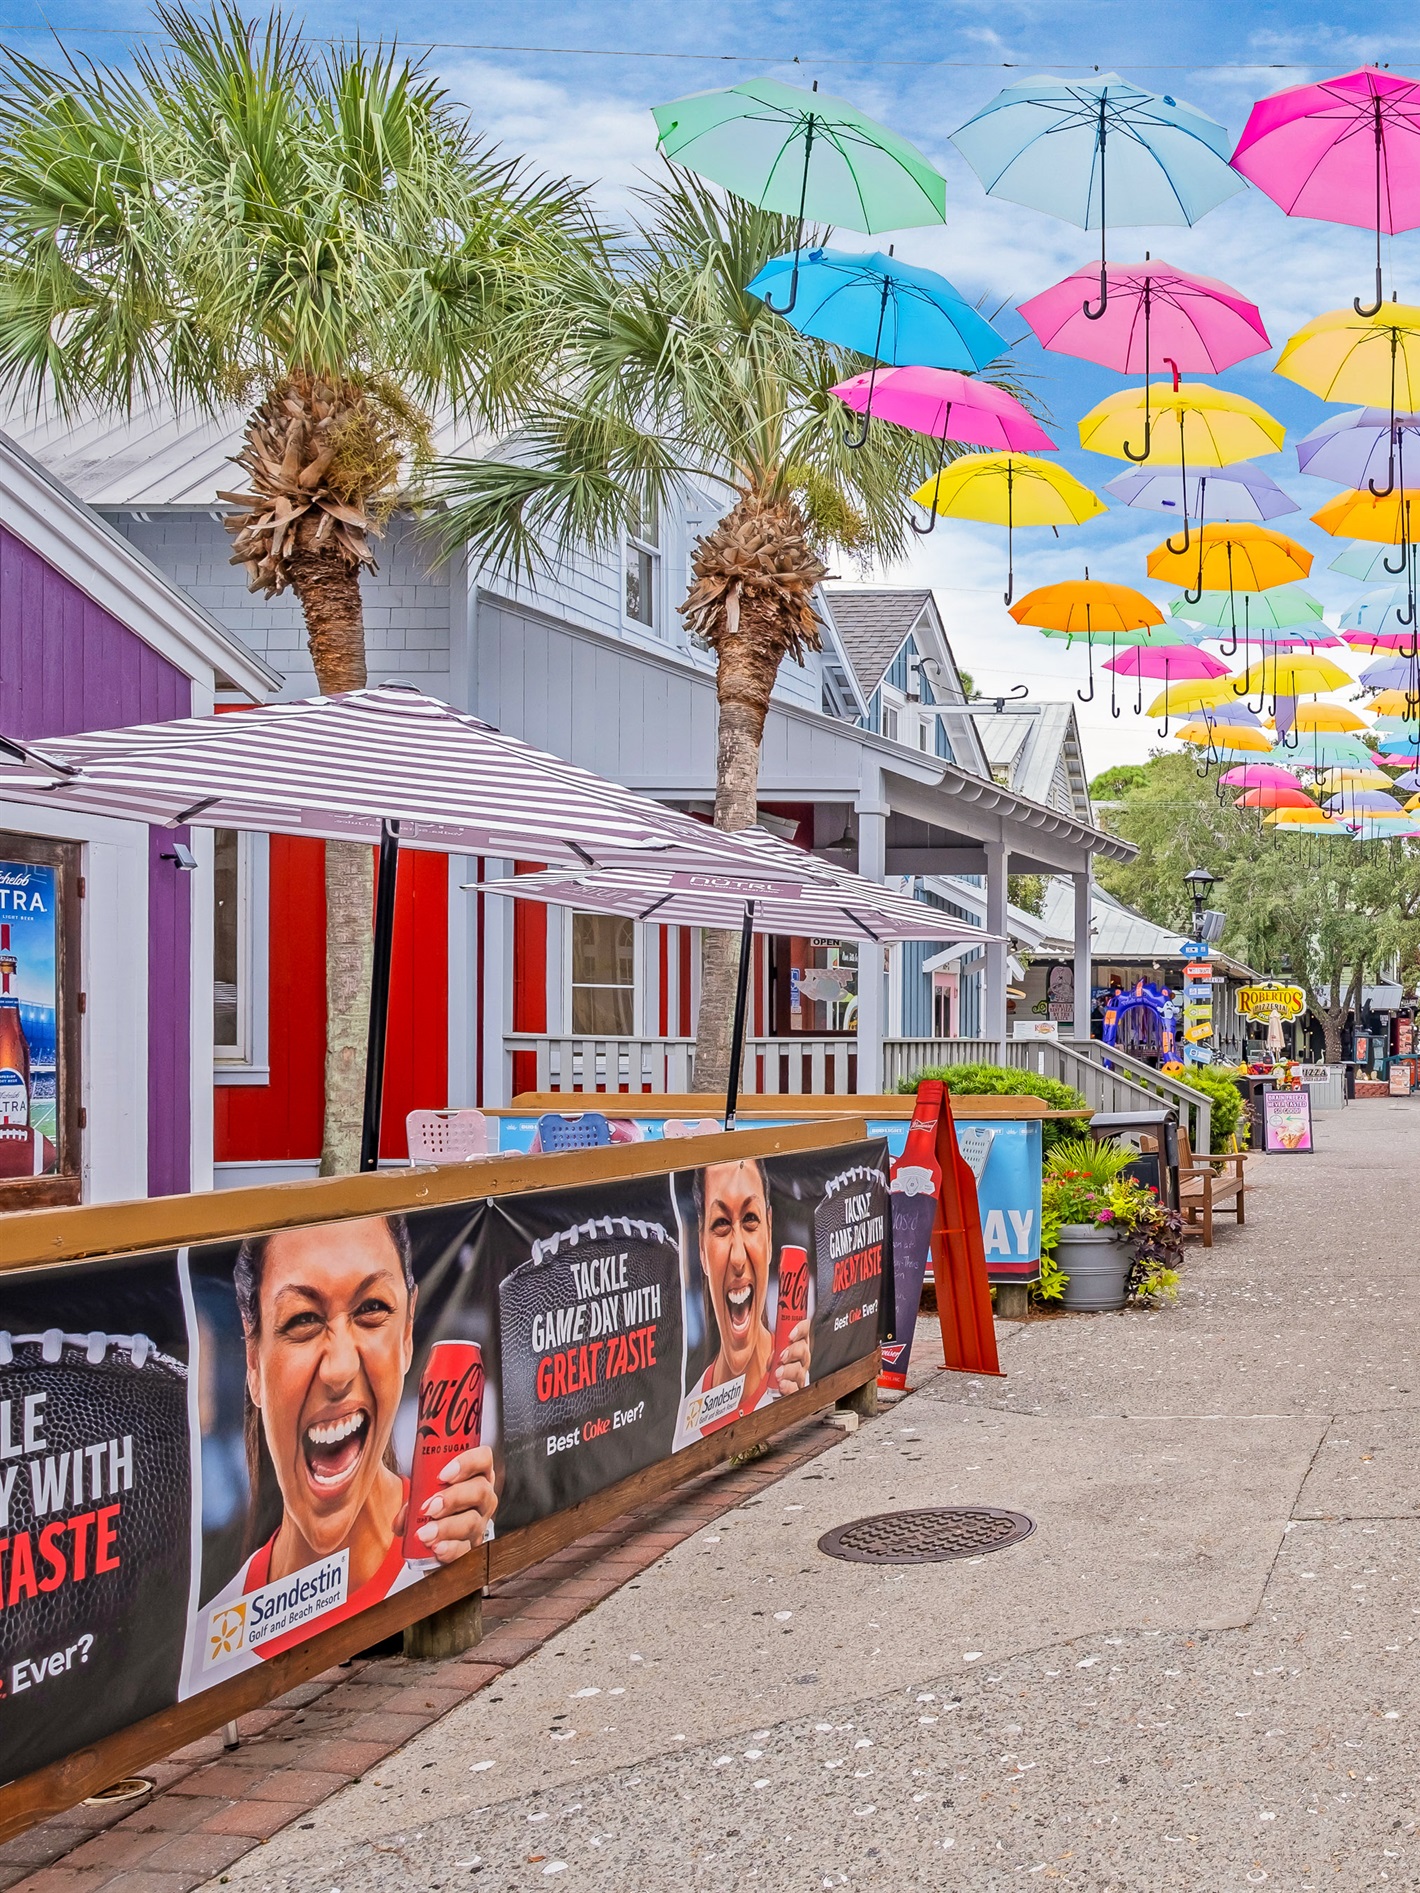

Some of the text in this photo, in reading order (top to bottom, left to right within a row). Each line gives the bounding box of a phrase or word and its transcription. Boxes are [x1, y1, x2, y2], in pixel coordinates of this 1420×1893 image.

[813, 938, 840, 946] OPEN
[845, 1192, 871, 1224] TACKLE
[829, 1215, 884, 1260] GAME DAY WITH
[570, 1253, 629, 1300] TACKLE
[832, 1255, 859, 1294] GREAT
[859, 1244, 882, 1282] TASTE
[532, 1284, 662, 1353] GAME DAY WITH
[834, 1313, 849, 1332] Best
[862, 1299, 879, 1318] Ever?
[536, 1324, 657, 1402] GREAT TASTE
[702, 1381, 742, 1414] Sandestin
[422, 1443, 441, 1455] ZERO
[546, 1401, 645, 1456] Best Coke Ever?
[30, 1434, 133, 1517] WITH
[248, 1591, 341, 1643] Golf and Beach Resort
[250, 1563, 342, 1626] Sandestin
[12, 1633, 94, 1695] Ever?
